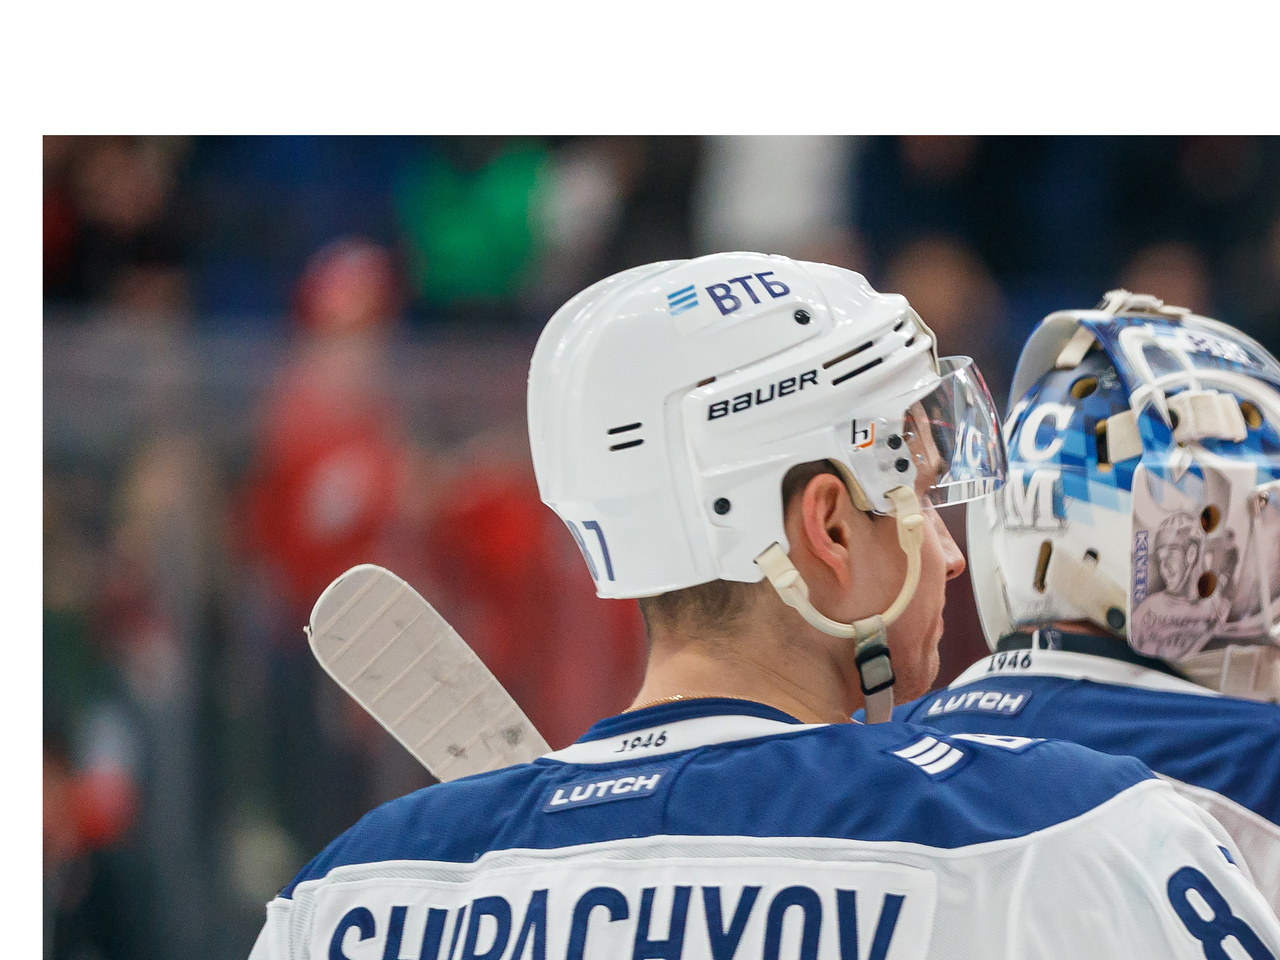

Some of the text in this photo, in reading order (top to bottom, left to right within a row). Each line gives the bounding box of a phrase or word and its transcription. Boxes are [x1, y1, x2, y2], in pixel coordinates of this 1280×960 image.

[705, 271, 790, 316] ВТБ
[987, 651, 1033, 673] 1946
[927, 691, 1025, 717] LUTCH
[614, 730, 668, 754] 1946
[550, 773, 662, 806] LUTCH
